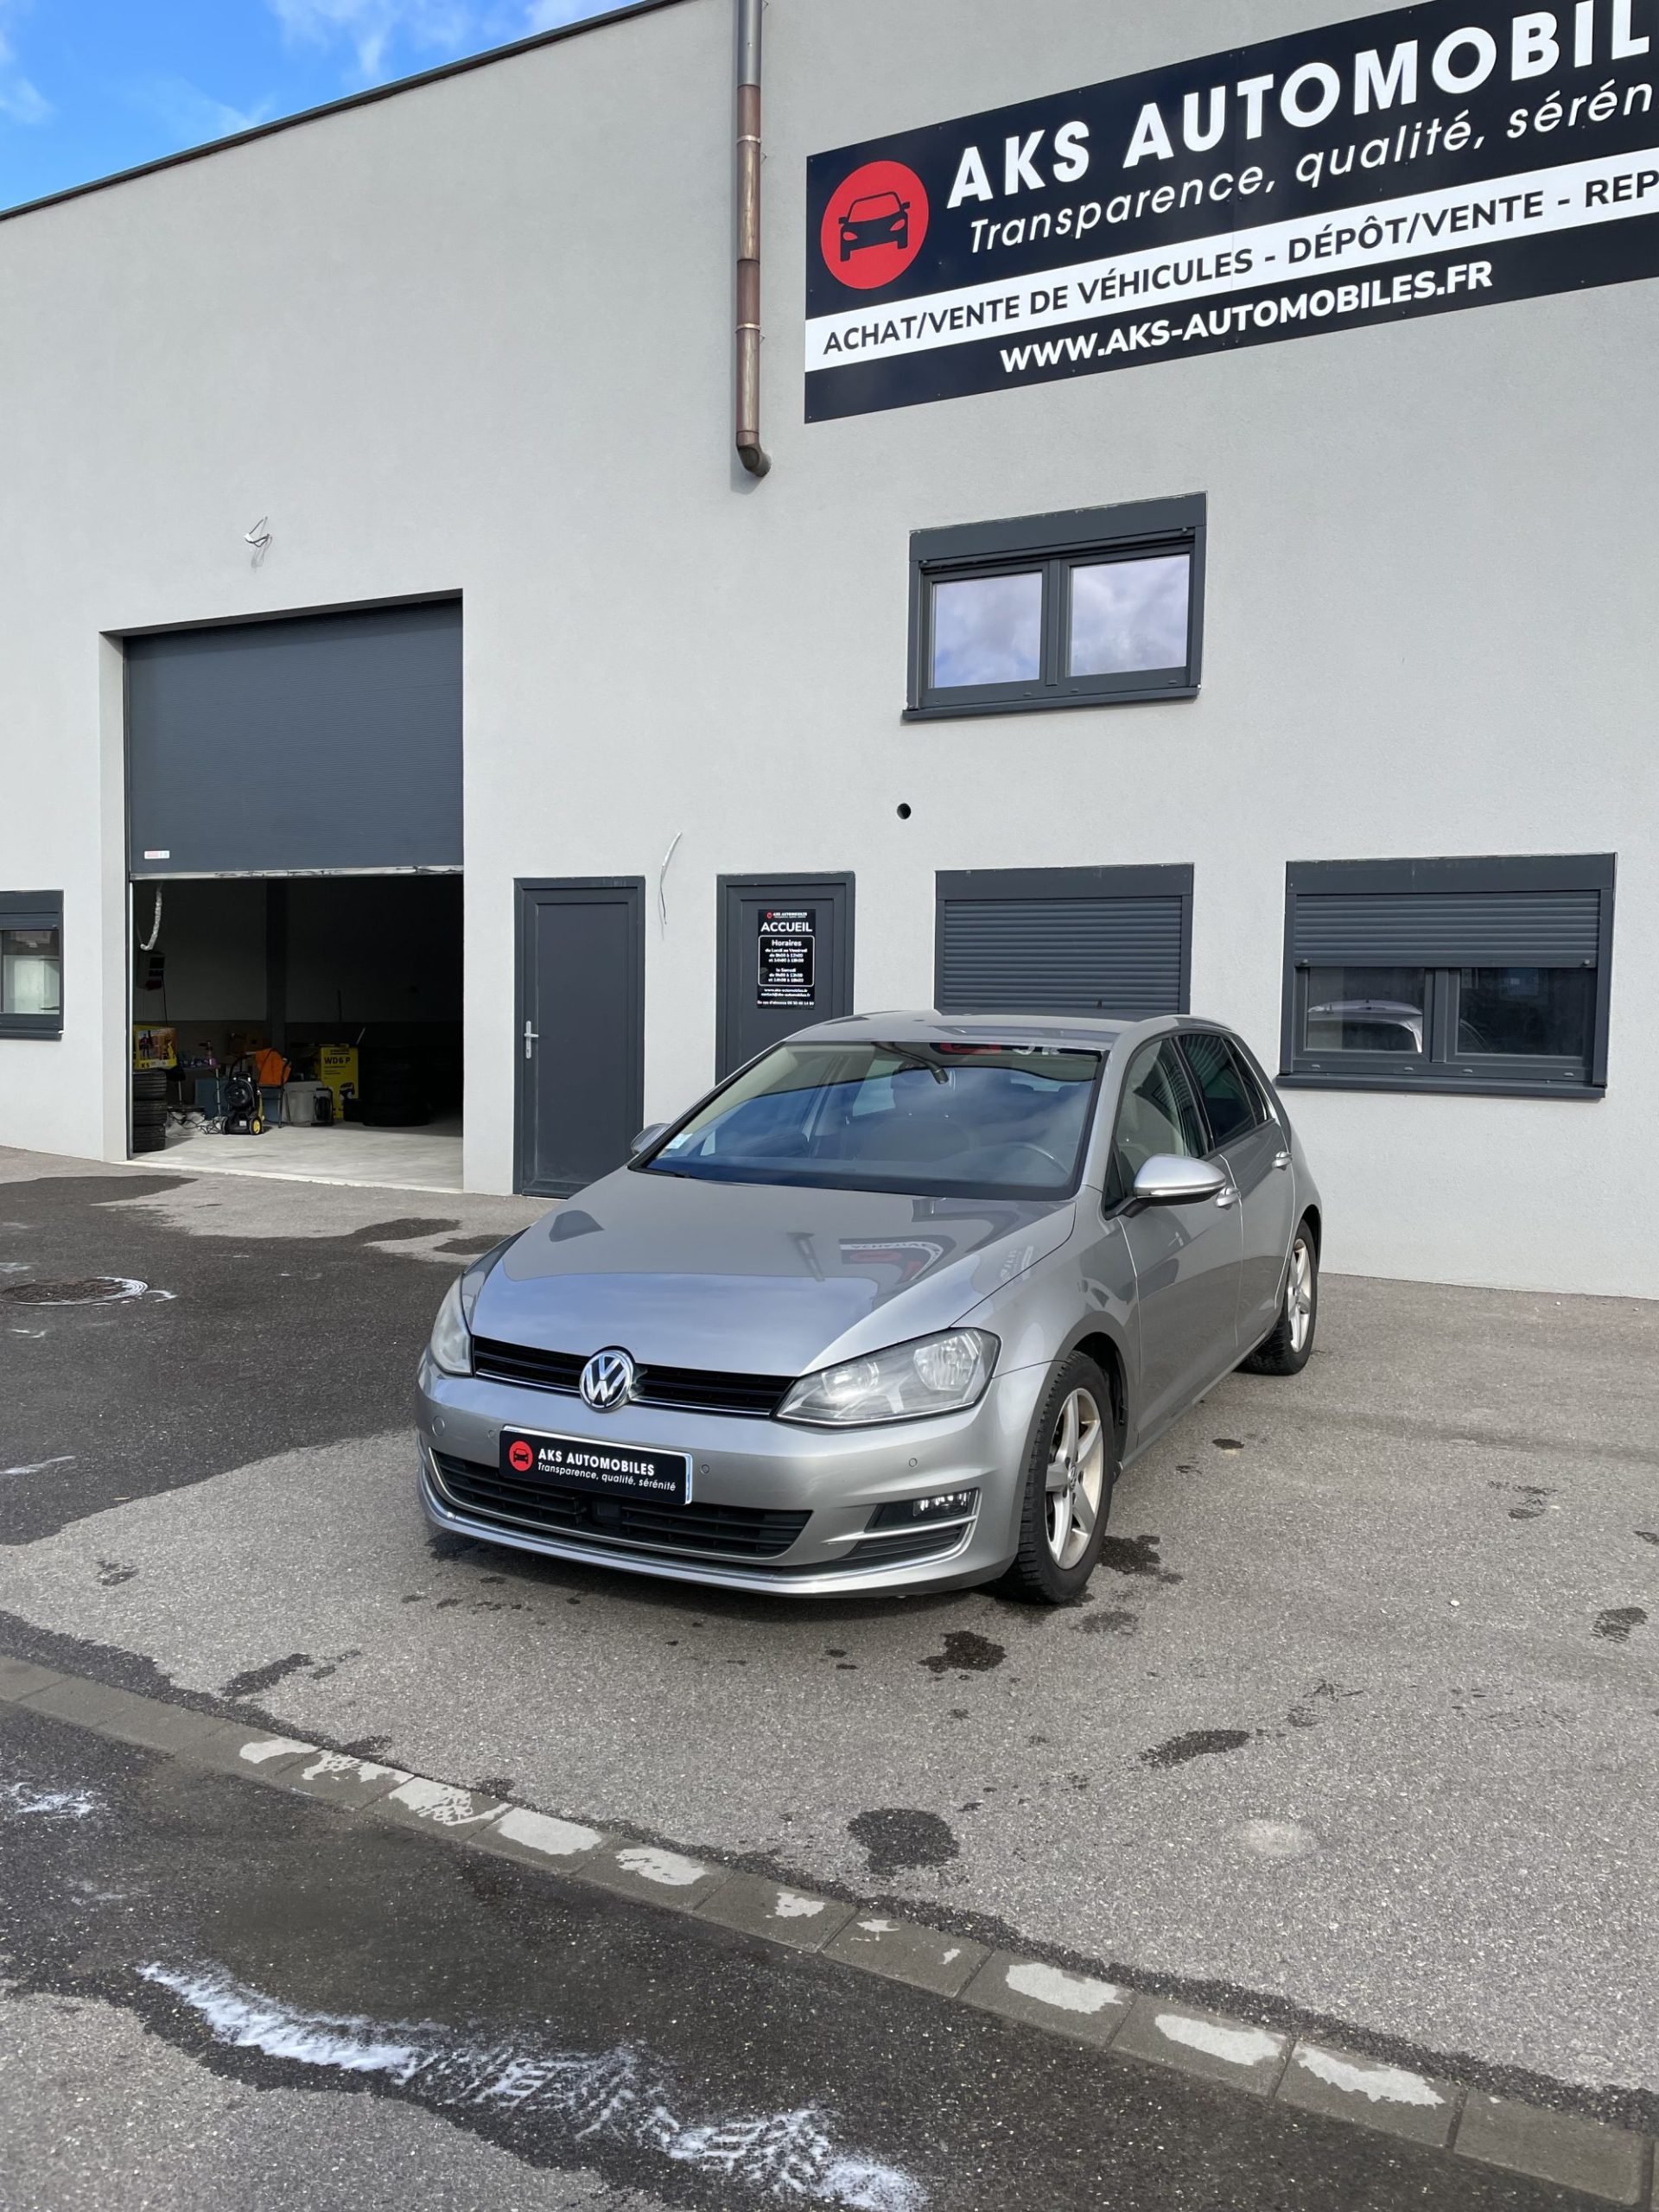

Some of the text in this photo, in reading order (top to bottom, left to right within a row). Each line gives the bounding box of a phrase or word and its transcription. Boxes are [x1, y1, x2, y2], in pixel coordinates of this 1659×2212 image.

[947, 121, 1089, 208] AKS
[970, 166, 1276, 253] Transparence,
[1297, 110, 1485, 188] qualité,
[823, 295, 1019, 355] ACHAT/VENTE
[1030, 285, 1068, 315] DE
[1077, 248, 1253, 303] VÉHICULES
[1288, 190, 1542, 264] DÉPÔT/VENTE
[1001, 260, 1493, 372] WWW.AKS-AUTOMOBILES.FR
[760, 922, 813, 932] ACCUEIL
[537, 1462, 676, 1491] Transparence, qualité, sérénité
[538, 1448, 654, 1476] AKS AUTOMOBILES
